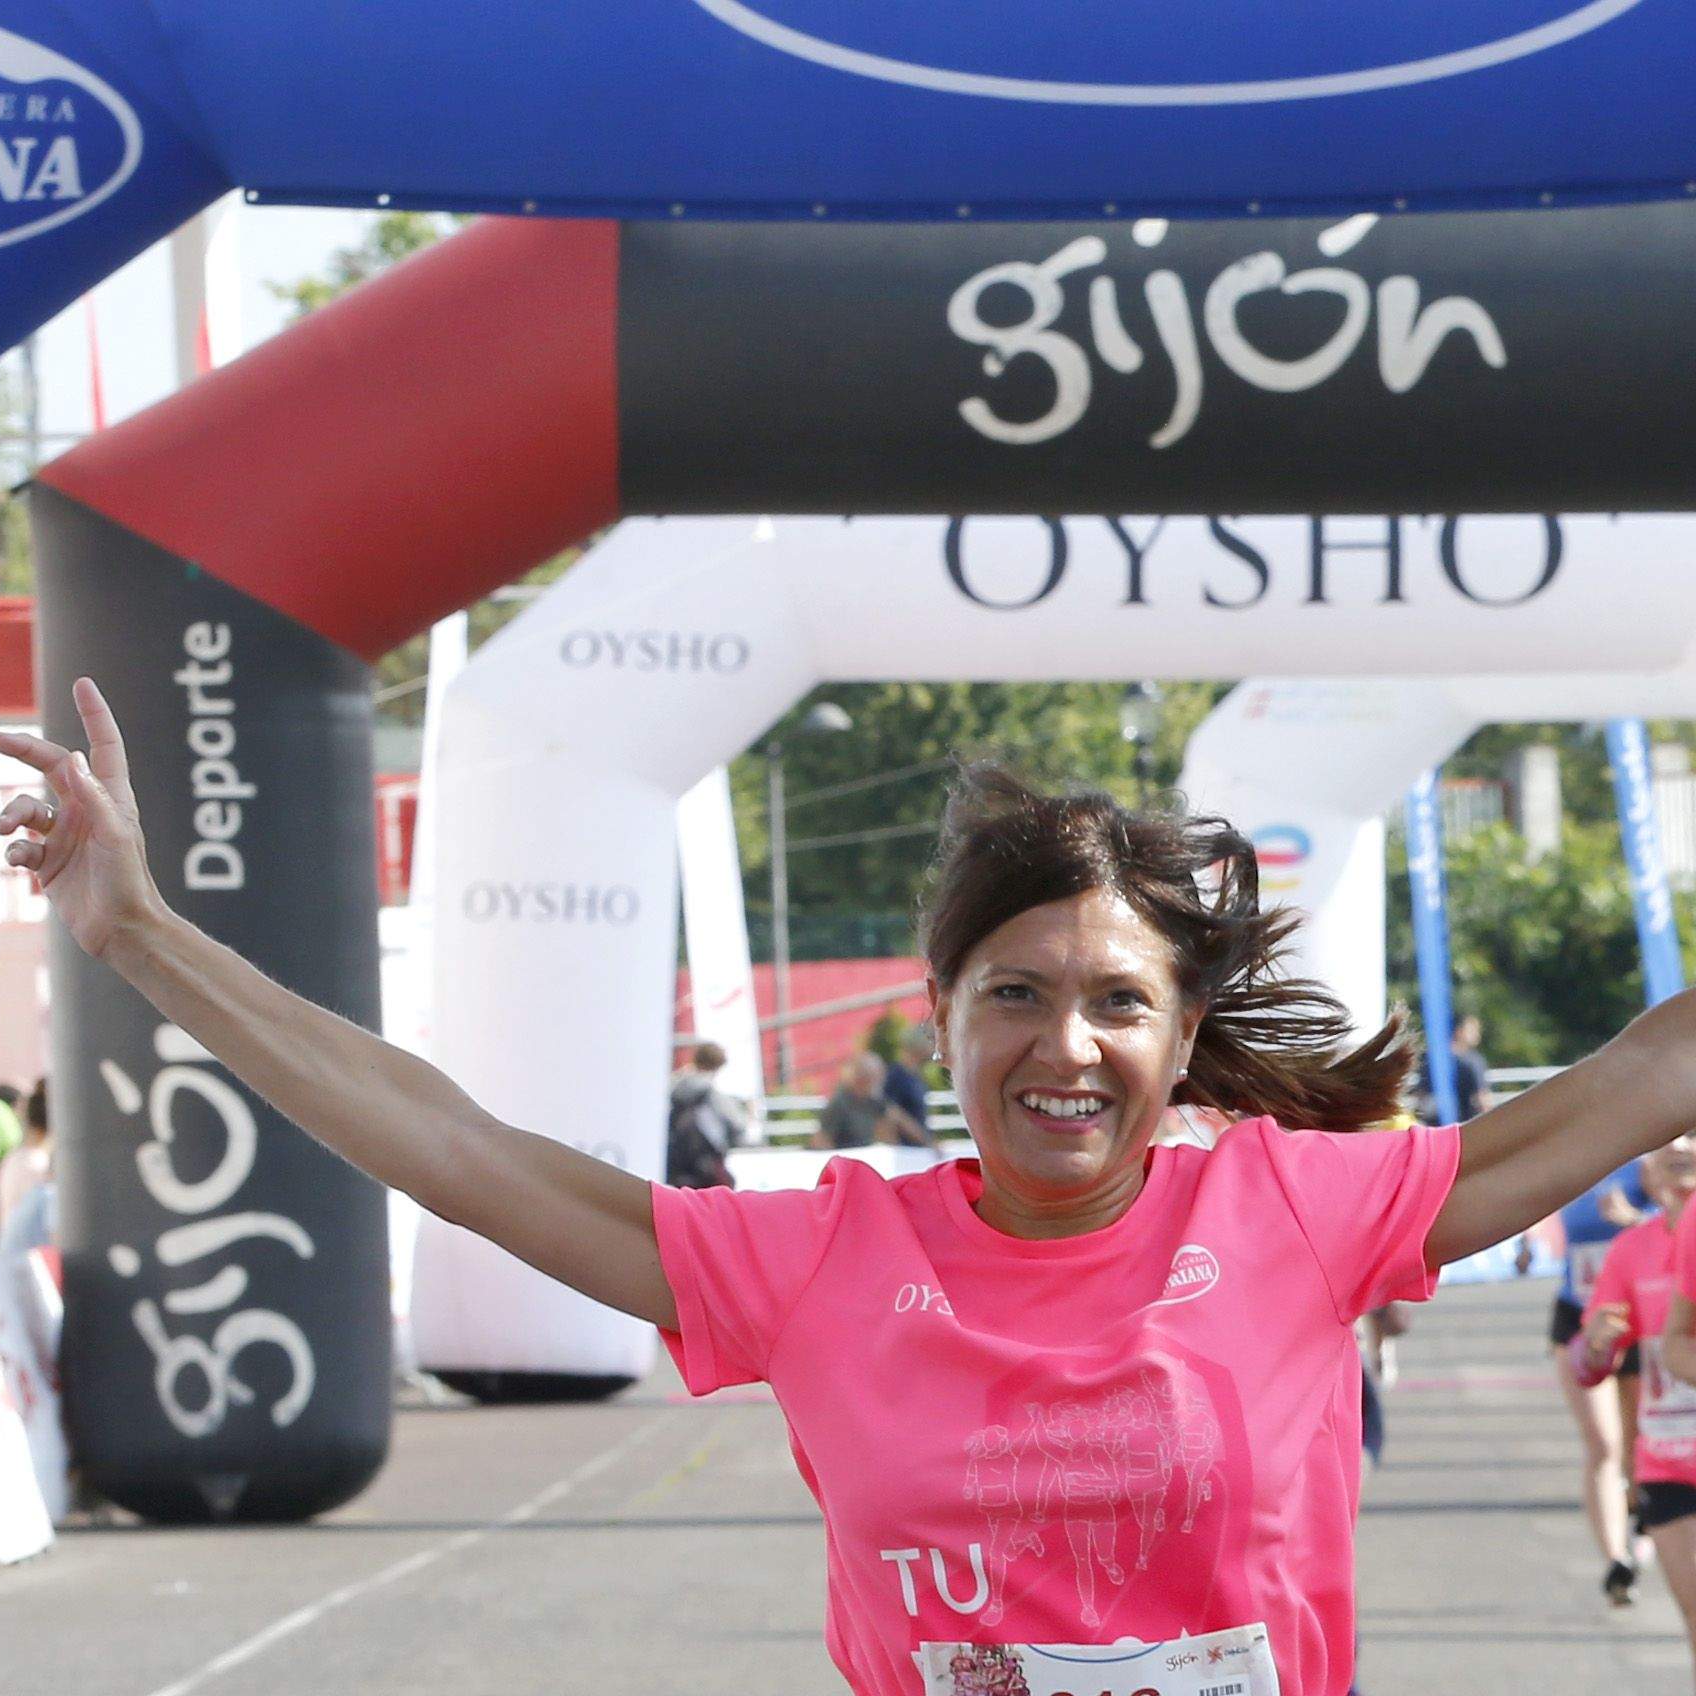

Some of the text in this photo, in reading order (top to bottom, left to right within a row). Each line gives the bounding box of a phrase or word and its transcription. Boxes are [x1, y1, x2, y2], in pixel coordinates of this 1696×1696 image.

[948, 212, 1506, 449] gijón
[941, 515, 1567, 610] OYSHO
[560, 628, 751, 674] OYSHO
[176, 620, 257, 892] Deporte
[461, 880, 640, 924] OYSHO
[880, 1543, 989, 1616] TU
